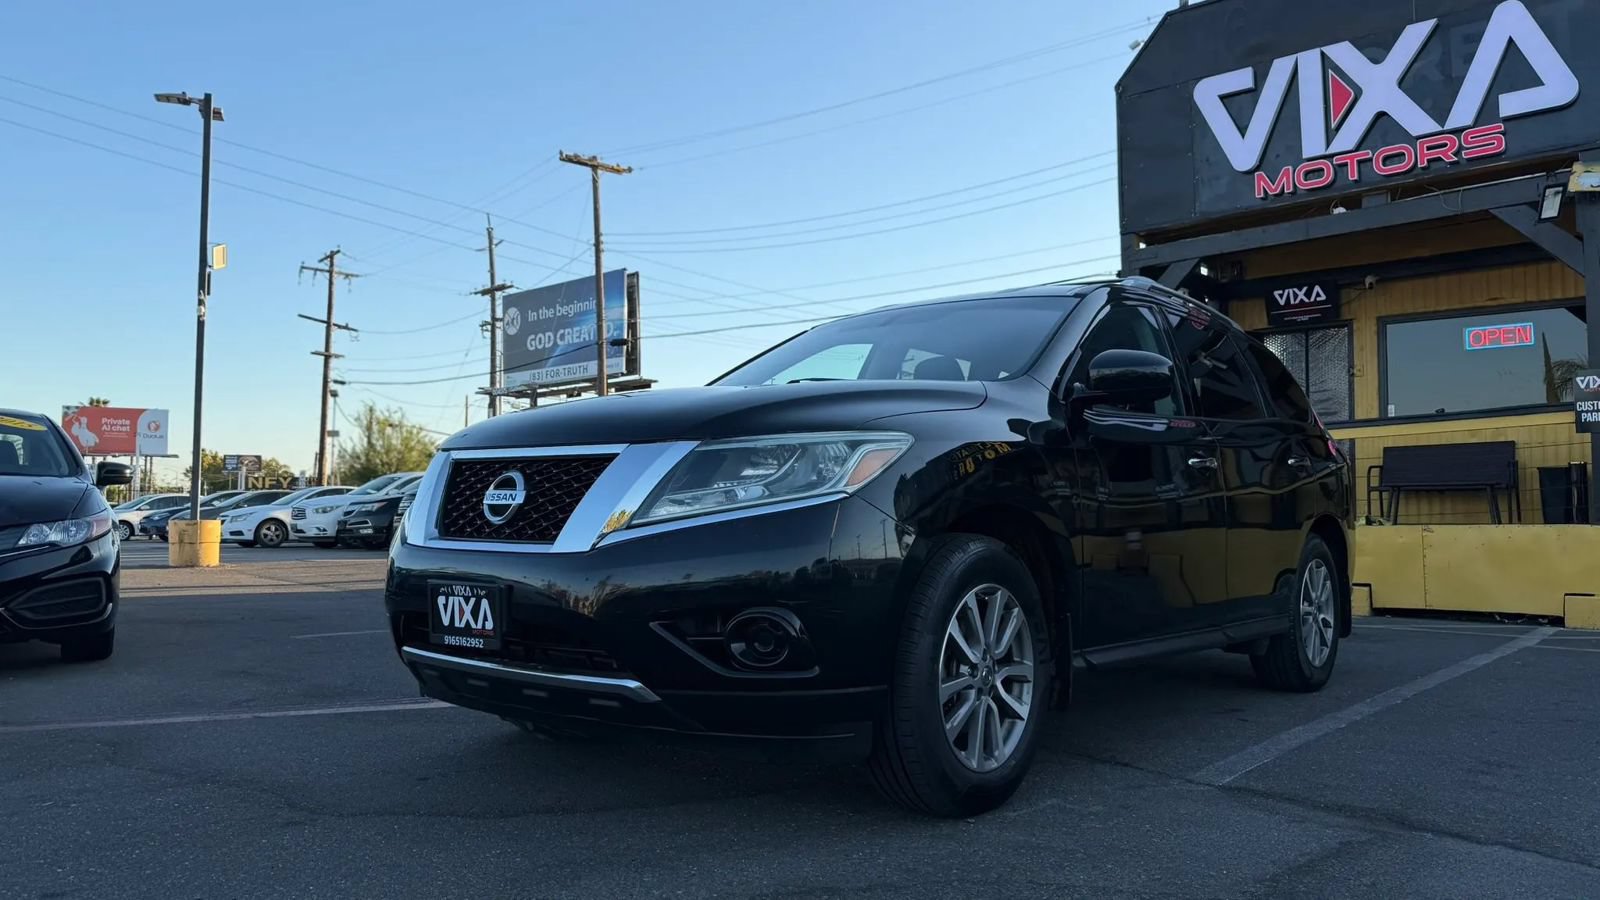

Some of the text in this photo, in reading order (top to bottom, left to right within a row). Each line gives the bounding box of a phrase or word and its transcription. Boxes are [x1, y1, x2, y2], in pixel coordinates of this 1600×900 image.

[1193, 0, 1580, 172] VIXA
[1254, 123, 1507, 198] MOTORS
[1273, 284, 1327, 306] VIXA
[528, 310, 538, 322] In
[539, 306, 554, 320] the
[526, 329, 554, 351] GOD
[1469, 325, 1531, 347] OPEN
[545, 364, 589, 380] FOR-TRUTH
[102, 417, 130, 425] Private
[453, 585, 472, 597] VIXA
[437, 595, 494, 630] VIXA
[444, 635, 485, 649] 9165162952
